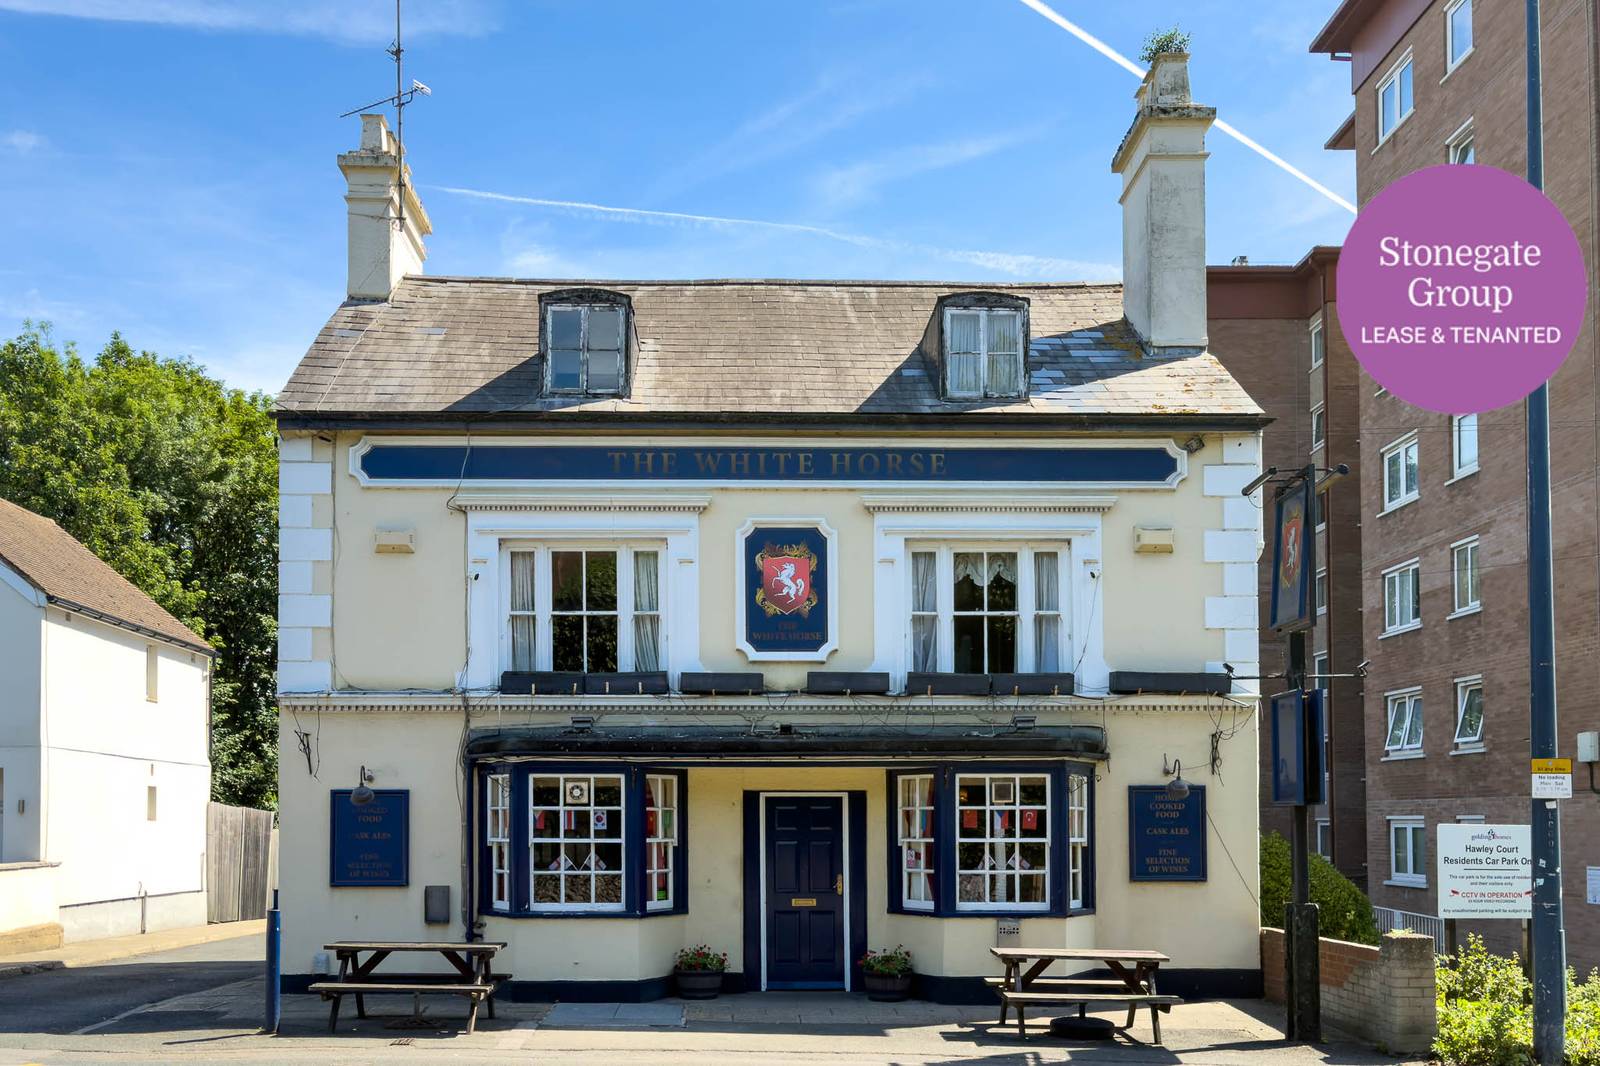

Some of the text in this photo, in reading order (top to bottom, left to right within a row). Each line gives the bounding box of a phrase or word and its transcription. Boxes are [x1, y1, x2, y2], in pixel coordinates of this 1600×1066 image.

[608, 452, 946, 475] THE WHITE HORSE
[752, 632, 822, 640] WHITE HORSE
[1465, 844, 1519, 854] Hawley Court
[1444, 856, 1483, 865] Residents
